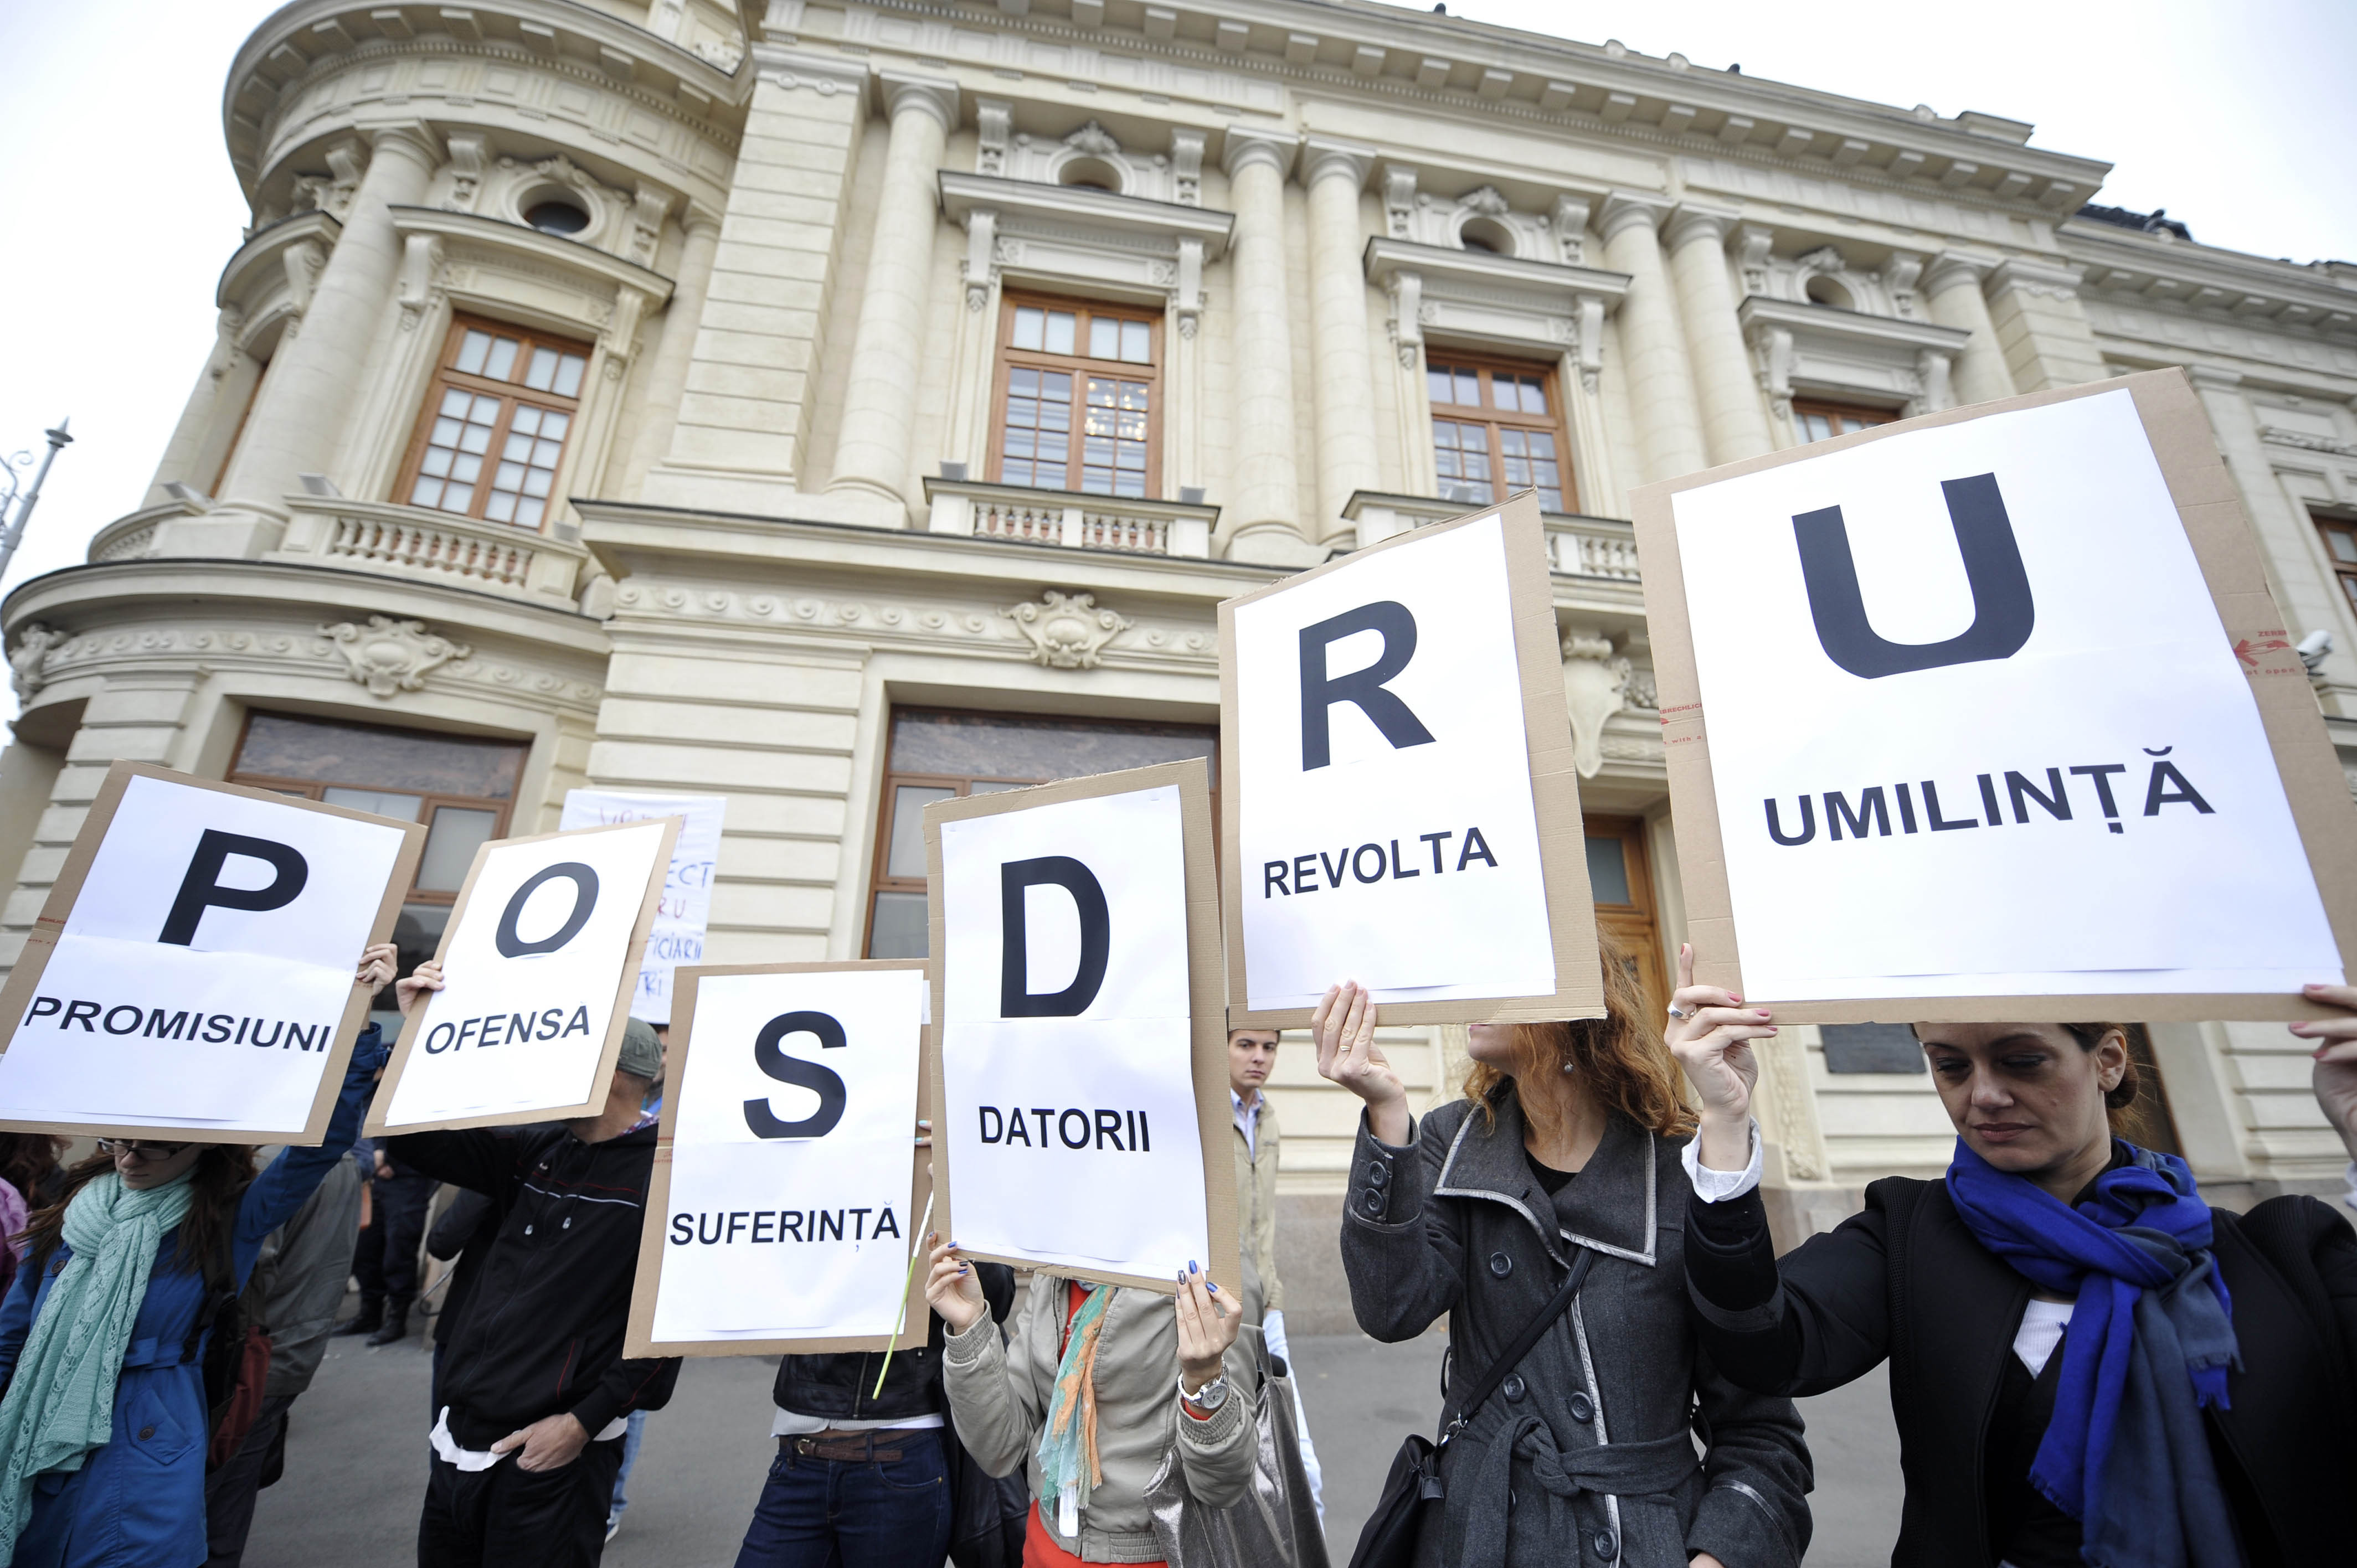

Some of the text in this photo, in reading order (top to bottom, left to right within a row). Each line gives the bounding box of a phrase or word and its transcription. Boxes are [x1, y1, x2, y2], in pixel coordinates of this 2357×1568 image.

[1792, 472, 2034, 679] U
[1299, 601, 1436, 771] R
[1764, 746, 2216, 845] UMILINȚĂ
[158, 829, 308, 946] P
[496, 863, 599, 958] O
[1265, 827, 1498, 899] REVOLTA
[1001, 856, 1110, 1018] D
[24, 996, 331, 1053] PROMISIUNI
[744, 1011, 847, 1139] S
[979, 1106, 1150, 1152] DATORII
